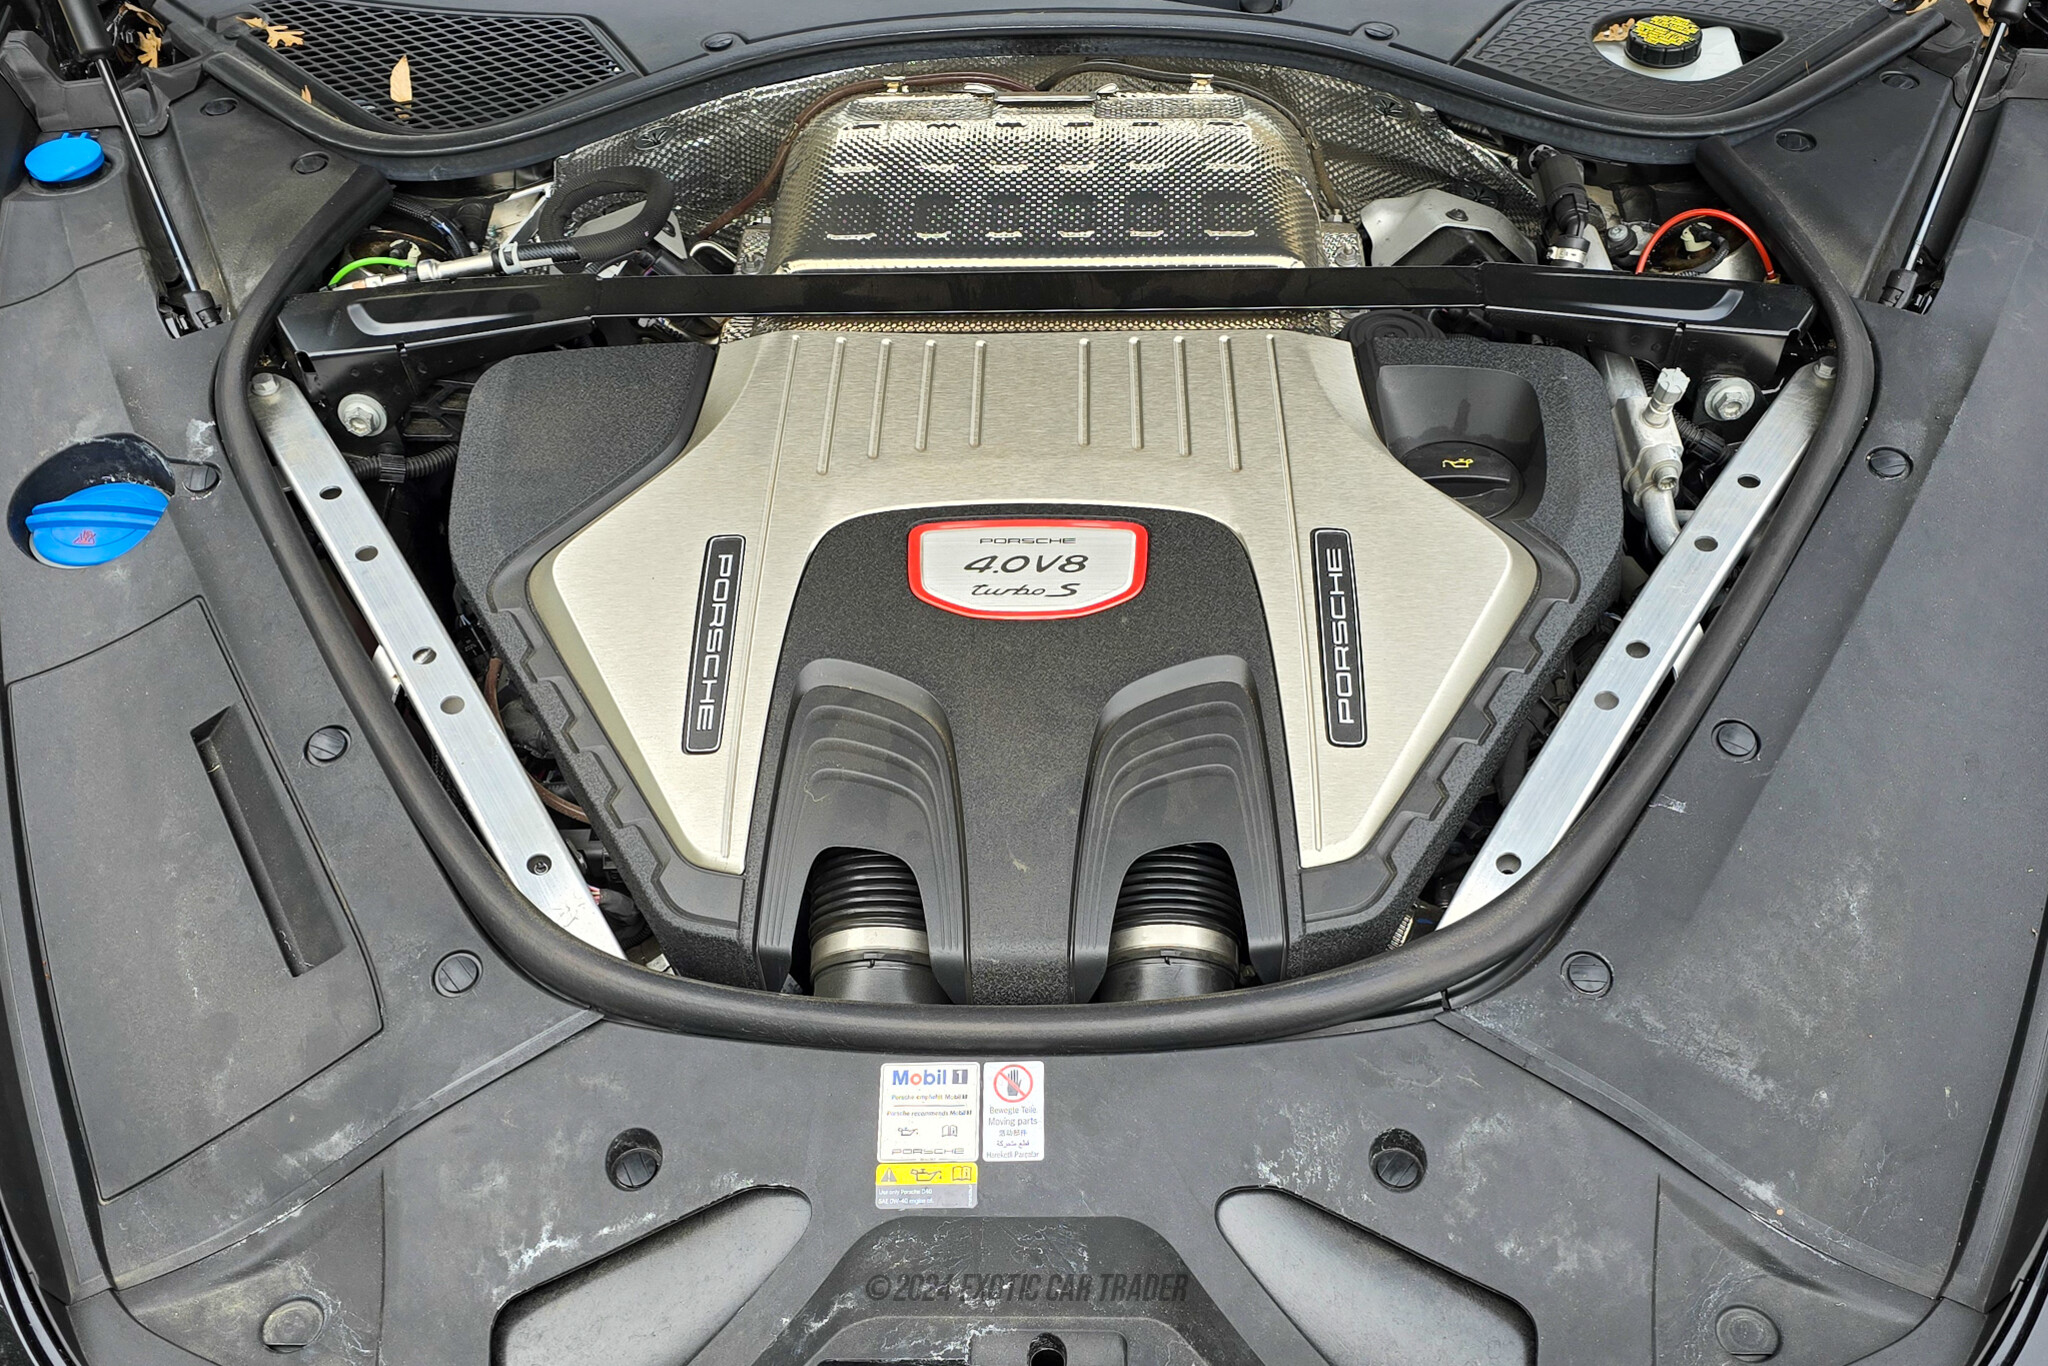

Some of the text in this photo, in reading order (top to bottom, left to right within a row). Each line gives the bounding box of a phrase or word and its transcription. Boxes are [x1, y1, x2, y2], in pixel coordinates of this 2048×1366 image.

[979, 537, 1077, 545] PORSCHE
[971, 583, 1081, 598] turbo S
[696, 554, 734, 731] PORSCHE
[1326, 548, 1355, 724] PORSCHE
[892, 1069, 947, 1086] Mobil
[988, 1117, 1038, 1127] Moving parts
[889, 1188, 900, 1196] only
